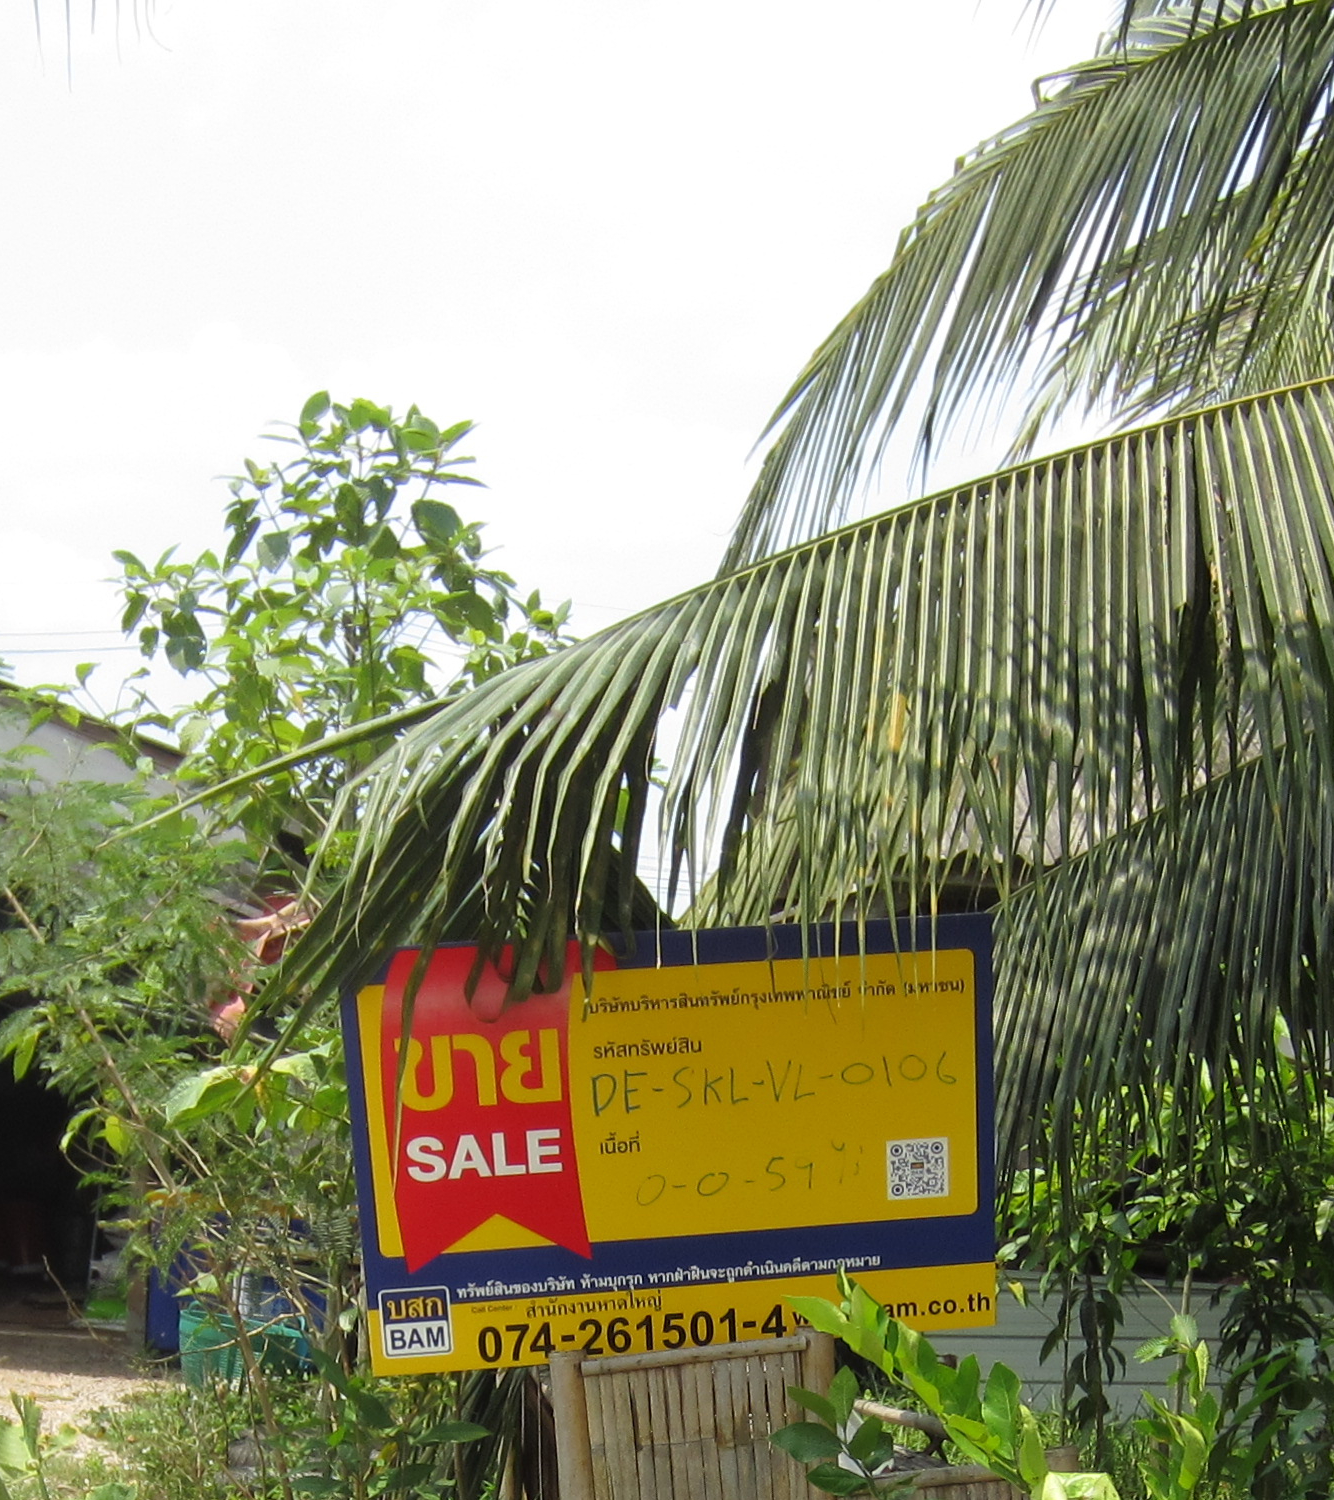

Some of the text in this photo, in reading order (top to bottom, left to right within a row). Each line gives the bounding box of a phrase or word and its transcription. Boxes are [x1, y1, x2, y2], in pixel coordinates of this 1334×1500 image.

[593, 1037, 702, 1059] รหัสทรัพย์สิน
[394, 1028, 563, 1112] ขาย
[406, 1128, 563, 1183] SALE
[600, 1130, 641, 1155] เนื้อที่
[457, 1275, 576, 1299] ทรัพย์สินของบริษัท
[580, 1272, 643, 1292] ห้ามบุกรุก
[386, 1296, 444, 1320] บสก
[526, 1290, 662, 1320] สำนักงานหาดใหญ่
[390, 1326, 445, 1350] BAM
[478, 1304, 787, 1363] 074-261501-4
